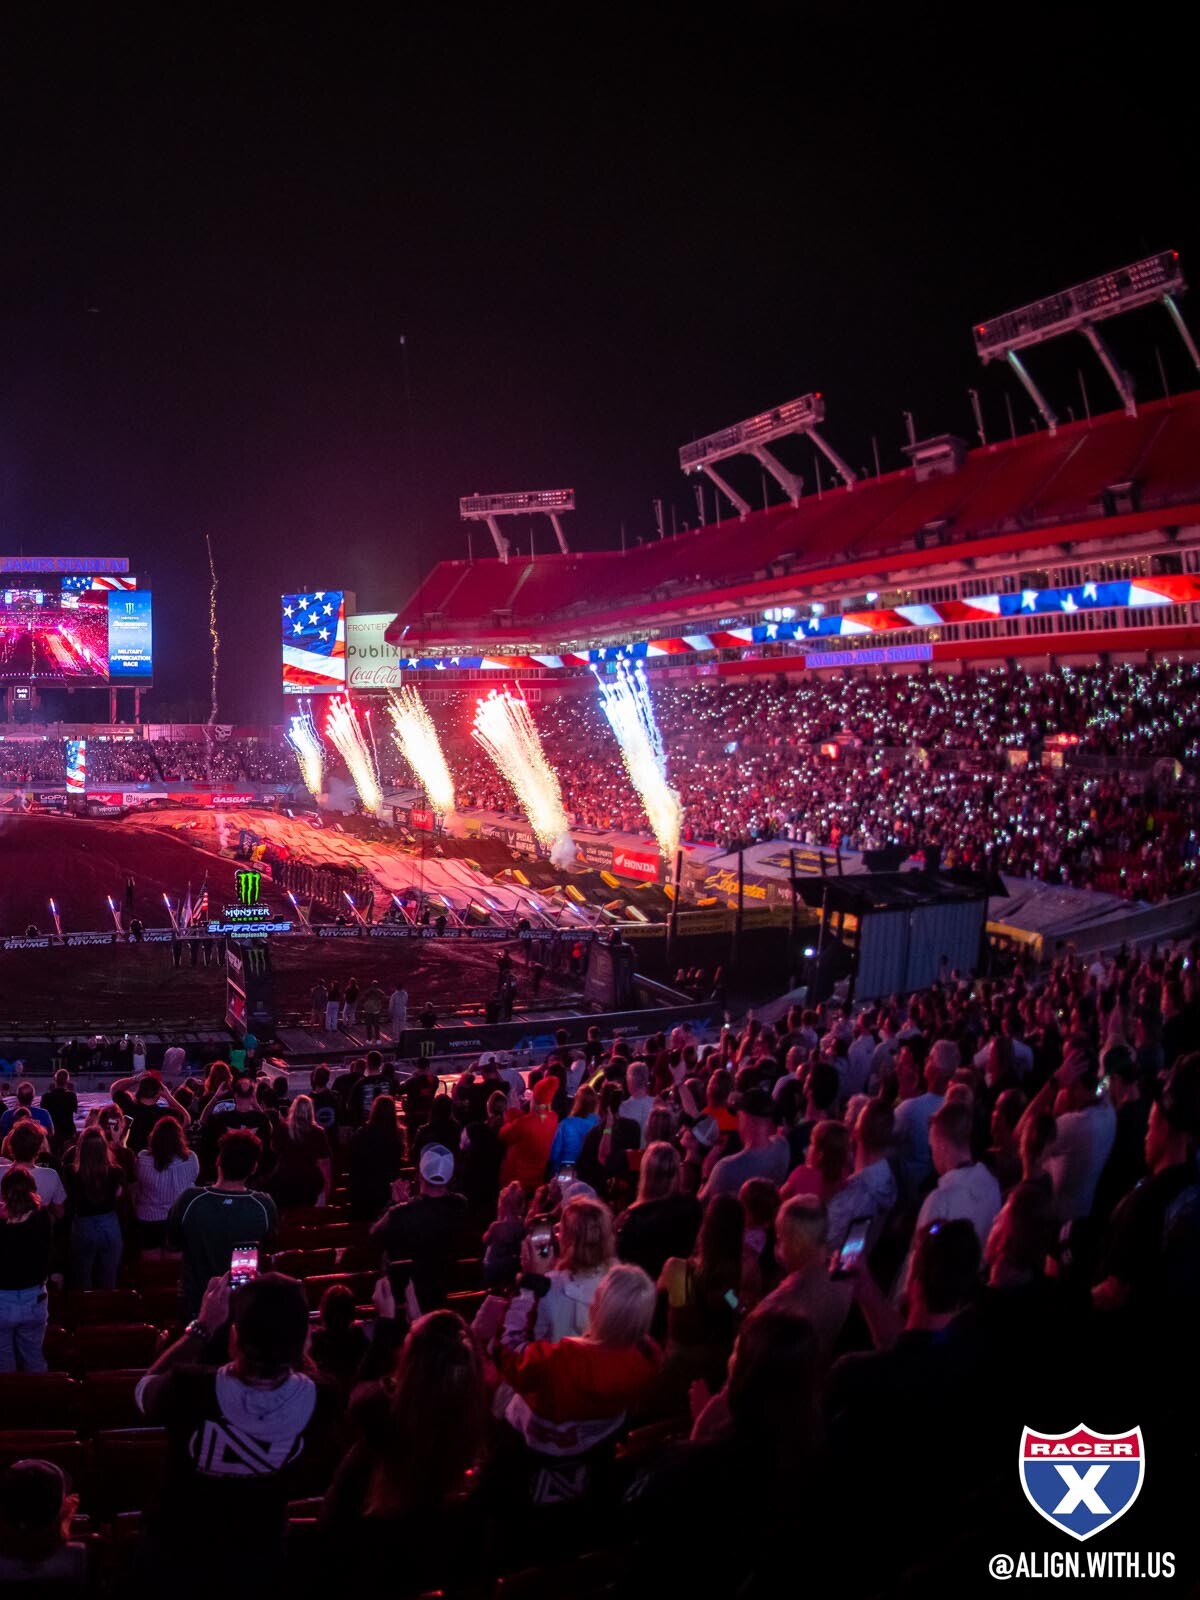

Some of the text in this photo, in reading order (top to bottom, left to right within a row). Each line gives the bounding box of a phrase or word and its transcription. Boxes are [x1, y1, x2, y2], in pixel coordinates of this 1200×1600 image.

[1, 558, 55, 572] JAMES
[57, 558, 127, 572] STADIUM
[347, 644, 400, 659] Publix
[349, 665, 399, 685] Coca-Cola
[623, 859, 657, 874] HONDA
[225, 908, 270, 917] MONSTER
[208, 923, 291, 933] SUPERCROSS
